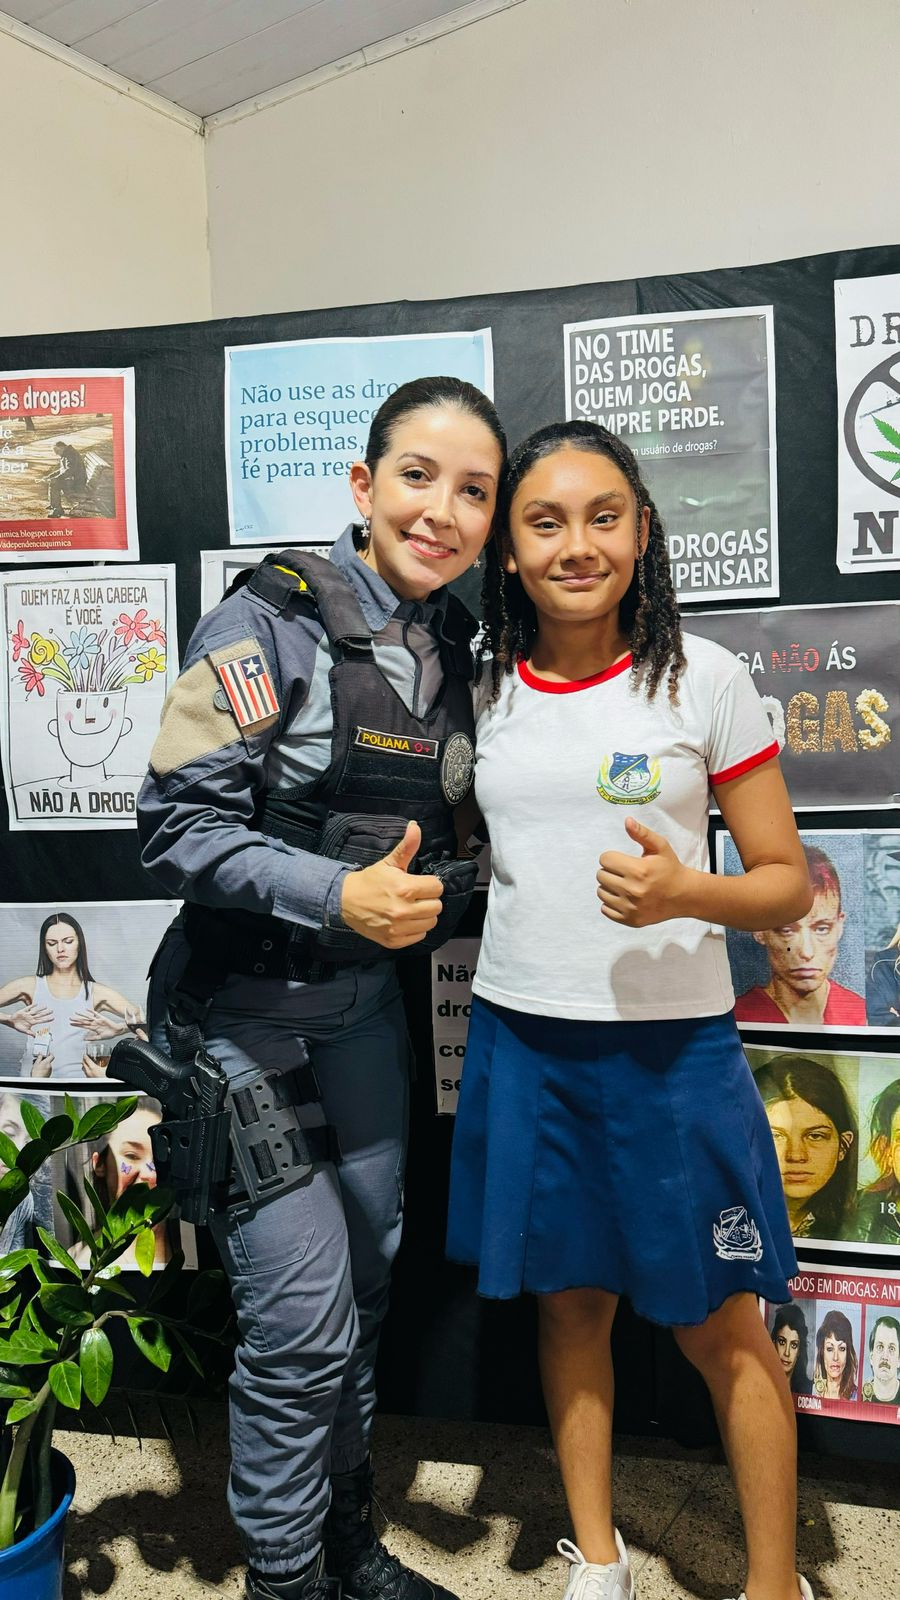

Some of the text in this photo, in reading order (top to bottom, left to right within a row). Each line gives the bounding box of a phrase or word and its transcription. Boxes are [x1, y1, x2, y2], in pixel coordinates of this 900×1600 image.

[849, 312, 900, 347] DR
[575, 328, 674, 361] NO TIME
[575, 354, 707, 385] DAS DROGAS,
[1, 384, 87, 415] às drogas!
[241, 384, 281, 405] Não
[288, 385, 325, 400] use
[332, 384, 355, 398] as
[575, 380, 692, 415] QUEM JOGA
[240, 412, 287, 434] para
[576, 406, 724, 435] MPRE PERDE.
[240, 432, 364, 458] problemas,
[641, 443, 670, 457] usuário
[672, 442, 683, 454] de
[685, 440, 717, 455] drogas?
[241, 458, 261, 479] fé
[266, 463, 315, 483] para
[669, 528, 769, 560] DROGAS
[670, 557, 770, 589] PENSAR
[21, 586, 148, 606] QUEM FAZ A SUA CABEÇA
[66, 605, 103, 625] É VOCÊ
[771, 643, 819, 672] NÃO
[826, 640, 857, 671] ÁS
[362, 732, 410, 750] POLIANA
[29, 788, 136, 813] NÃO A DROG
[880, 1202, 896, 1215] 18
[817, 1278, 832, 1294] EM
[834, 1280, 879, 1299] DROGAS:
